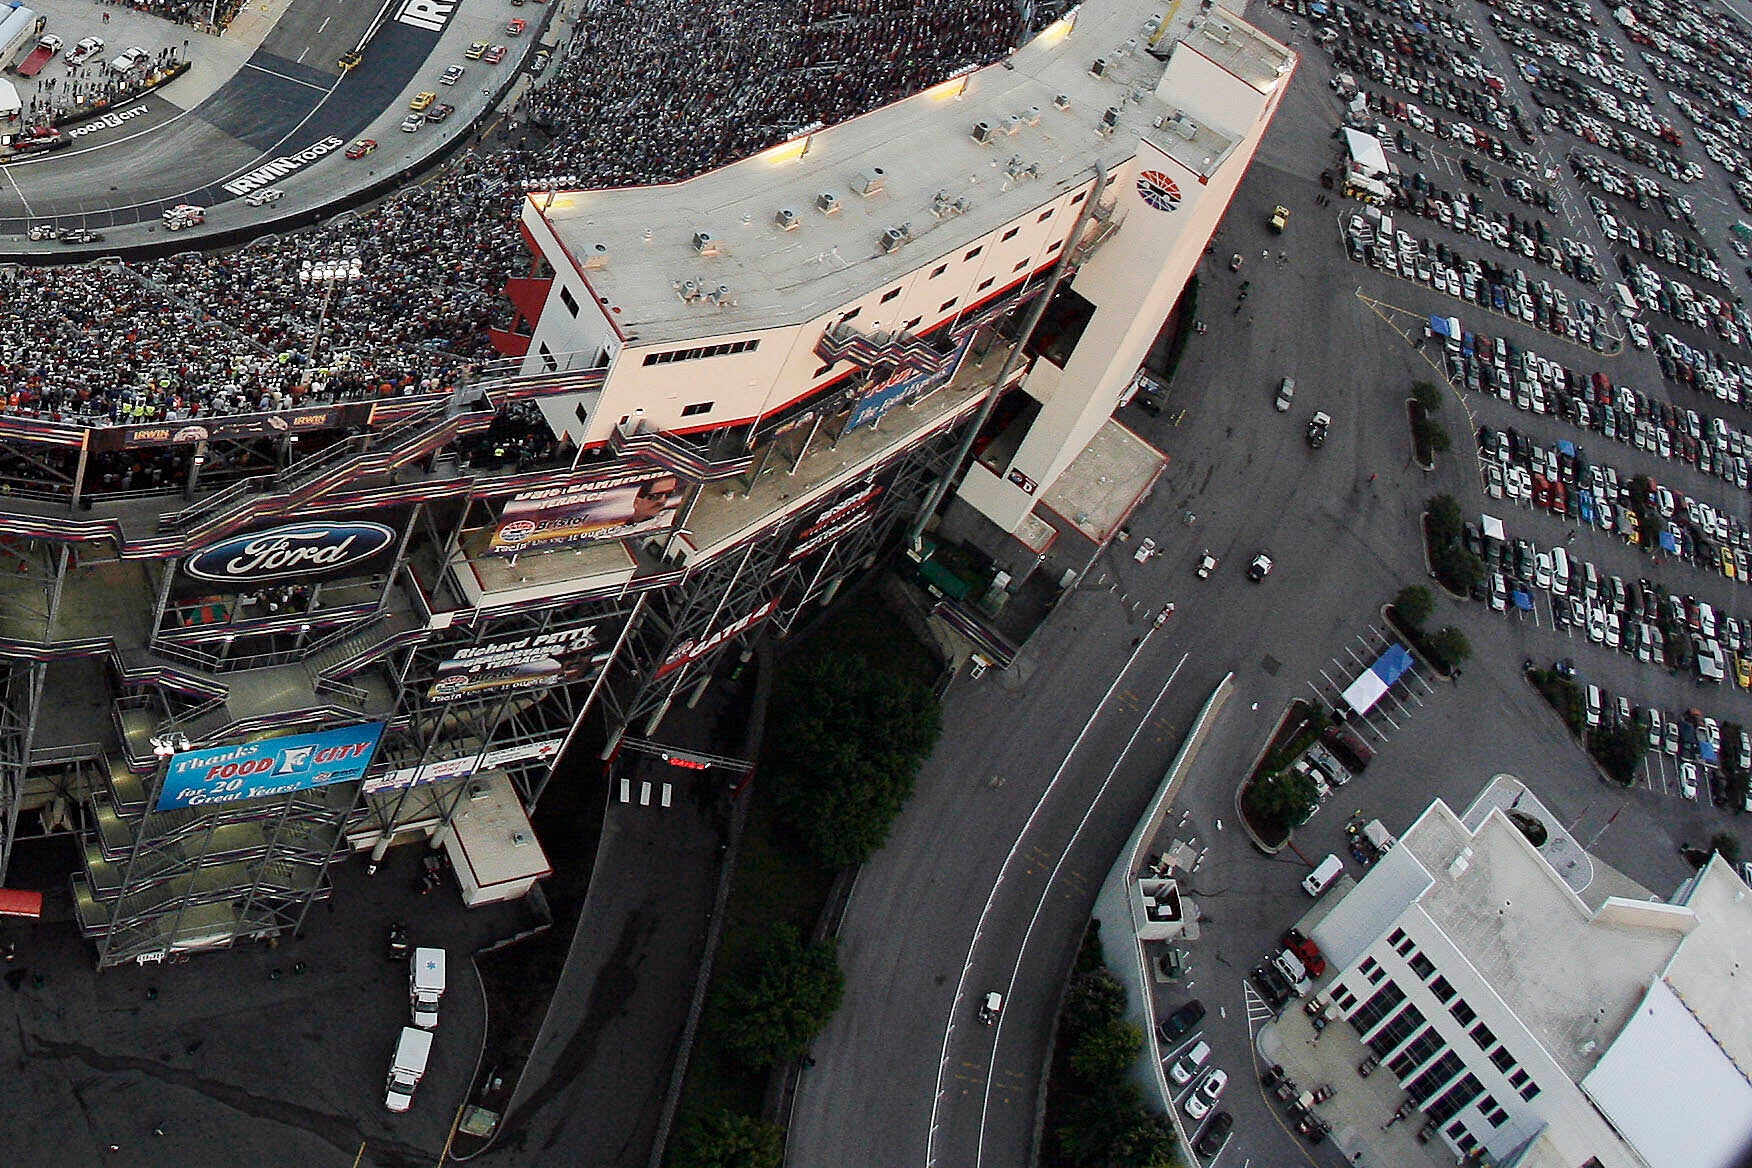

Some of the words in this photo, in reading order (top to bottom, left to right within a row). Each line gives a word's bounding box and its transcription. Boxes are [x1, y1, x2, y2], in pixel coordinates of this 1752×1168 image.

[69, 121, 106, 140] FOOD
[120, 105, 149, 120] CITY
[223, 158, 302, 196] IRWIN
[292, 136, 343, 164] TOOLS
[133, 429, 170, 440] IRWIN
[294, 414, 327, 425] IRWIN
[226, 531, 357, 574] Ford
[453, 637, 531, 660] Richard
[533, 625, 597, 646] PETTY
[689, 613, 752, 657] GATE
[485, 653, 550, 671] TERRACE
[175, 743, 260, 774] Thanks
[205, 757, 274, 781] FOOD
[314, 741, 372, 764] CITY
[176, 786, 207, 800] for
[209, 778, 244, 794] 20
[188, 792, 242, 806] Great
[247, 781, 301, 799] Years!
